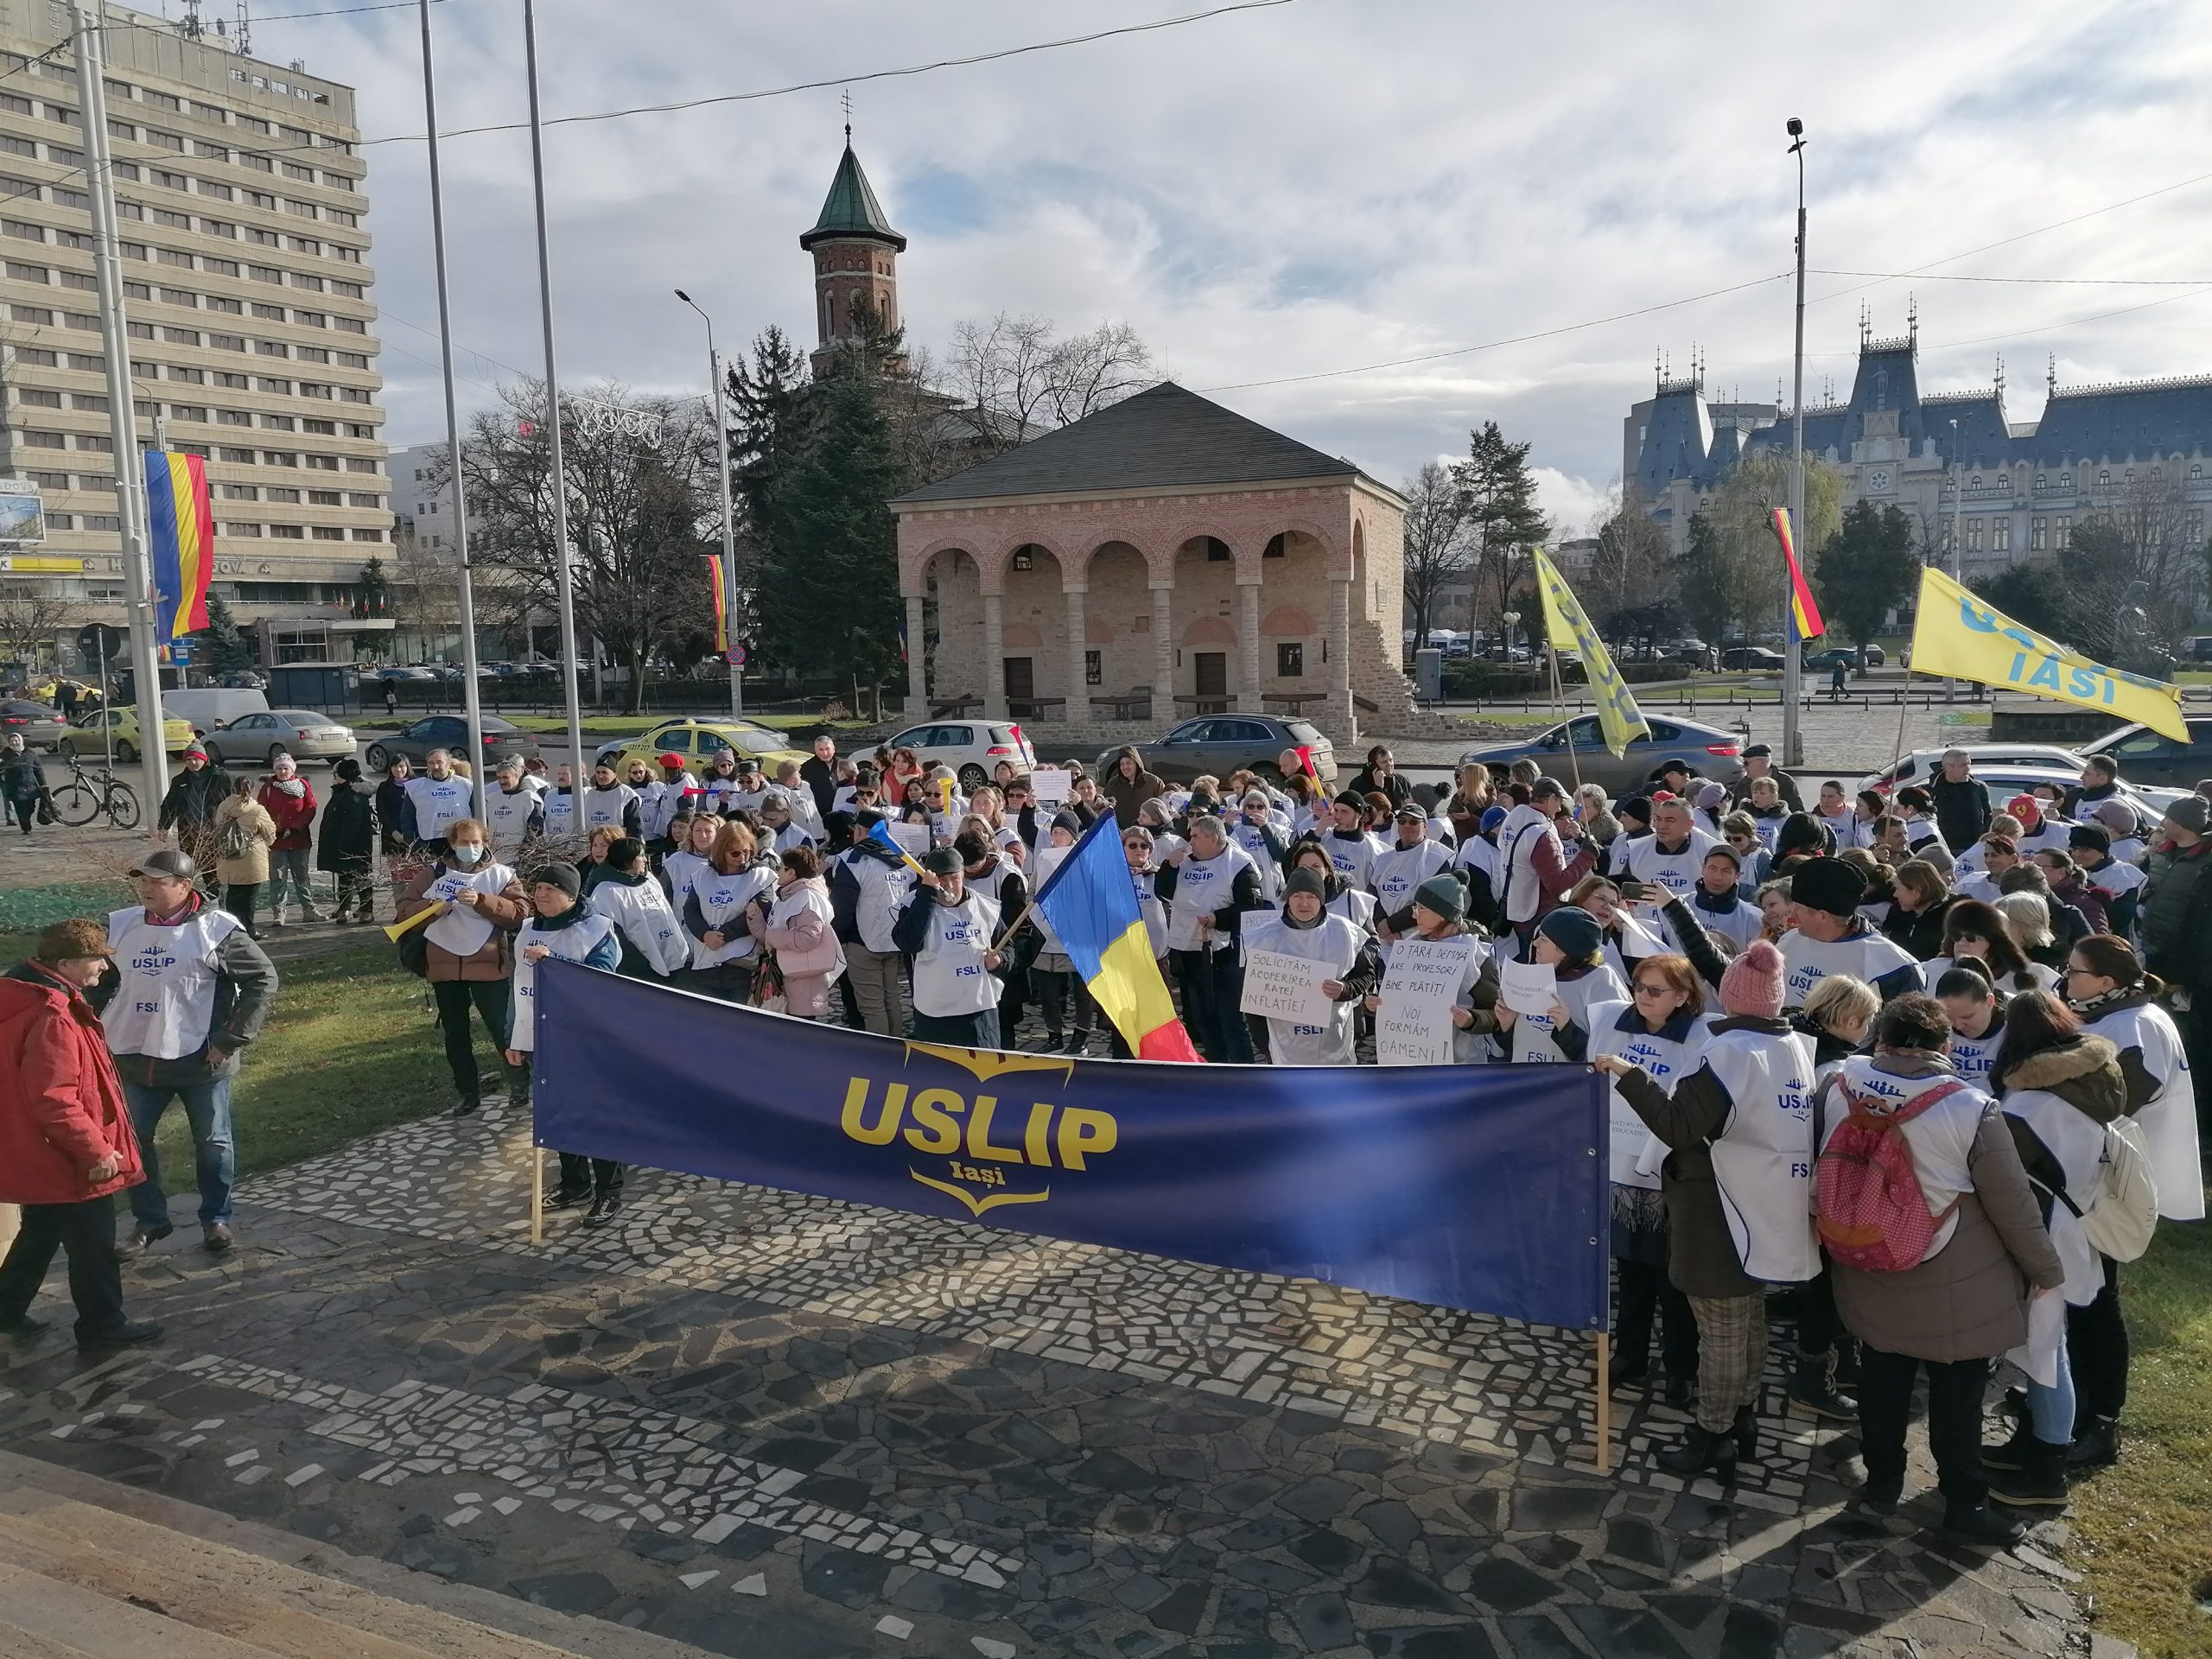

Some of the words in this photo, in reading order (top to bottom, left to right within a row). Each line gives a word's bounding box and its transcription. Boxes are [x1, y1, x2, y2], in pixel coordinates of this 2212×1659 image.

[1332, 860, 1356, 872] SLIP
[1184, 872, 1214, 880] USLIP
[945, 929, 982, 941] USLIP
[1396, 945, 1404, 955] O
[132, 957, 176, 969] USLIP
[956, 965, 982, 977] FSLI
[1412, 963, 1459, 976] PROFESORI
[1249, 969, 1313, 988] ACOPERIREA
[1264, 983, 1295, 996] RATEI
[1385, 980, 1403, 991] BINE
[1401, 1006, 1422, 1020] NOI
[1954, 1058, 1996, 1071] SLIP
[841, 1077, 1118, 1171] USLIP
[950, 1161, 1006, 1189] Iași
